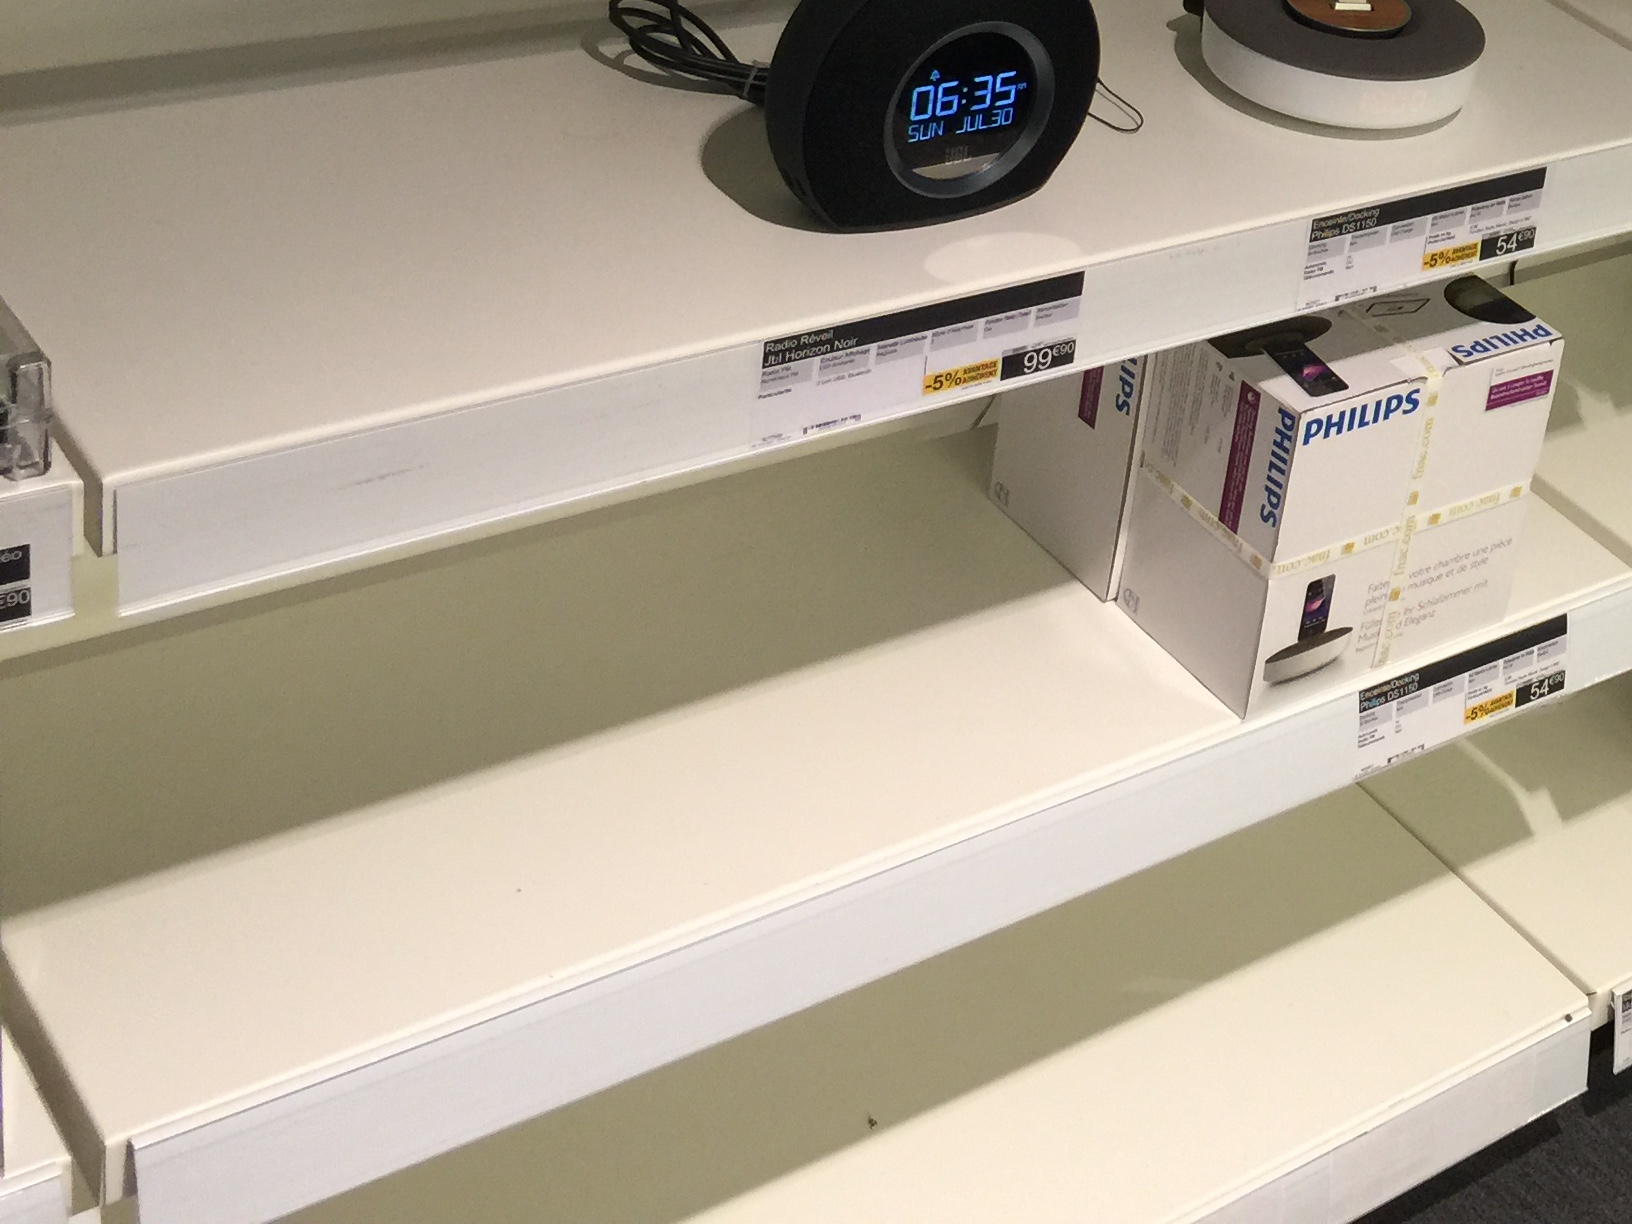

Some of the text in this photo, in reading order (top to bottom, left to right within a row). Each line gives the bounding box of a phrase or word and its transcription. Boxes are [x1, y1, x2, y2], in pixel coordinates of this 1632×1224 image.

[910, 70, 1017, 121] 06:35
[908, 121, 944, 143] SUN
[1311, 218, 1377, 240] Philips DS1150
[1313, 208, 1380, 230] Enceinte/Docking
[1424, 251, 1451, 268] -5%
[764, 337, 858, 367] Jbl Horizon Noir
[765, 329, 834, 353] Radio Réveil
[1451, 324, 1552, 359] PHILIPS
[925, 370, 961, 391] -5%
[1302, 387, 1422, 446] PHILIPS
[1260, 407, 1296, 528] PHILIPS
[1409, 538, 1513, 579] votre chambre une pièce
[1407, 557, 1489, 591] musique et de style
[1473, 579, 1488, 591] mit
[1360, 683, 1419, 712] Philips DS1150
[1465, 705, 1488, 721] -5%
